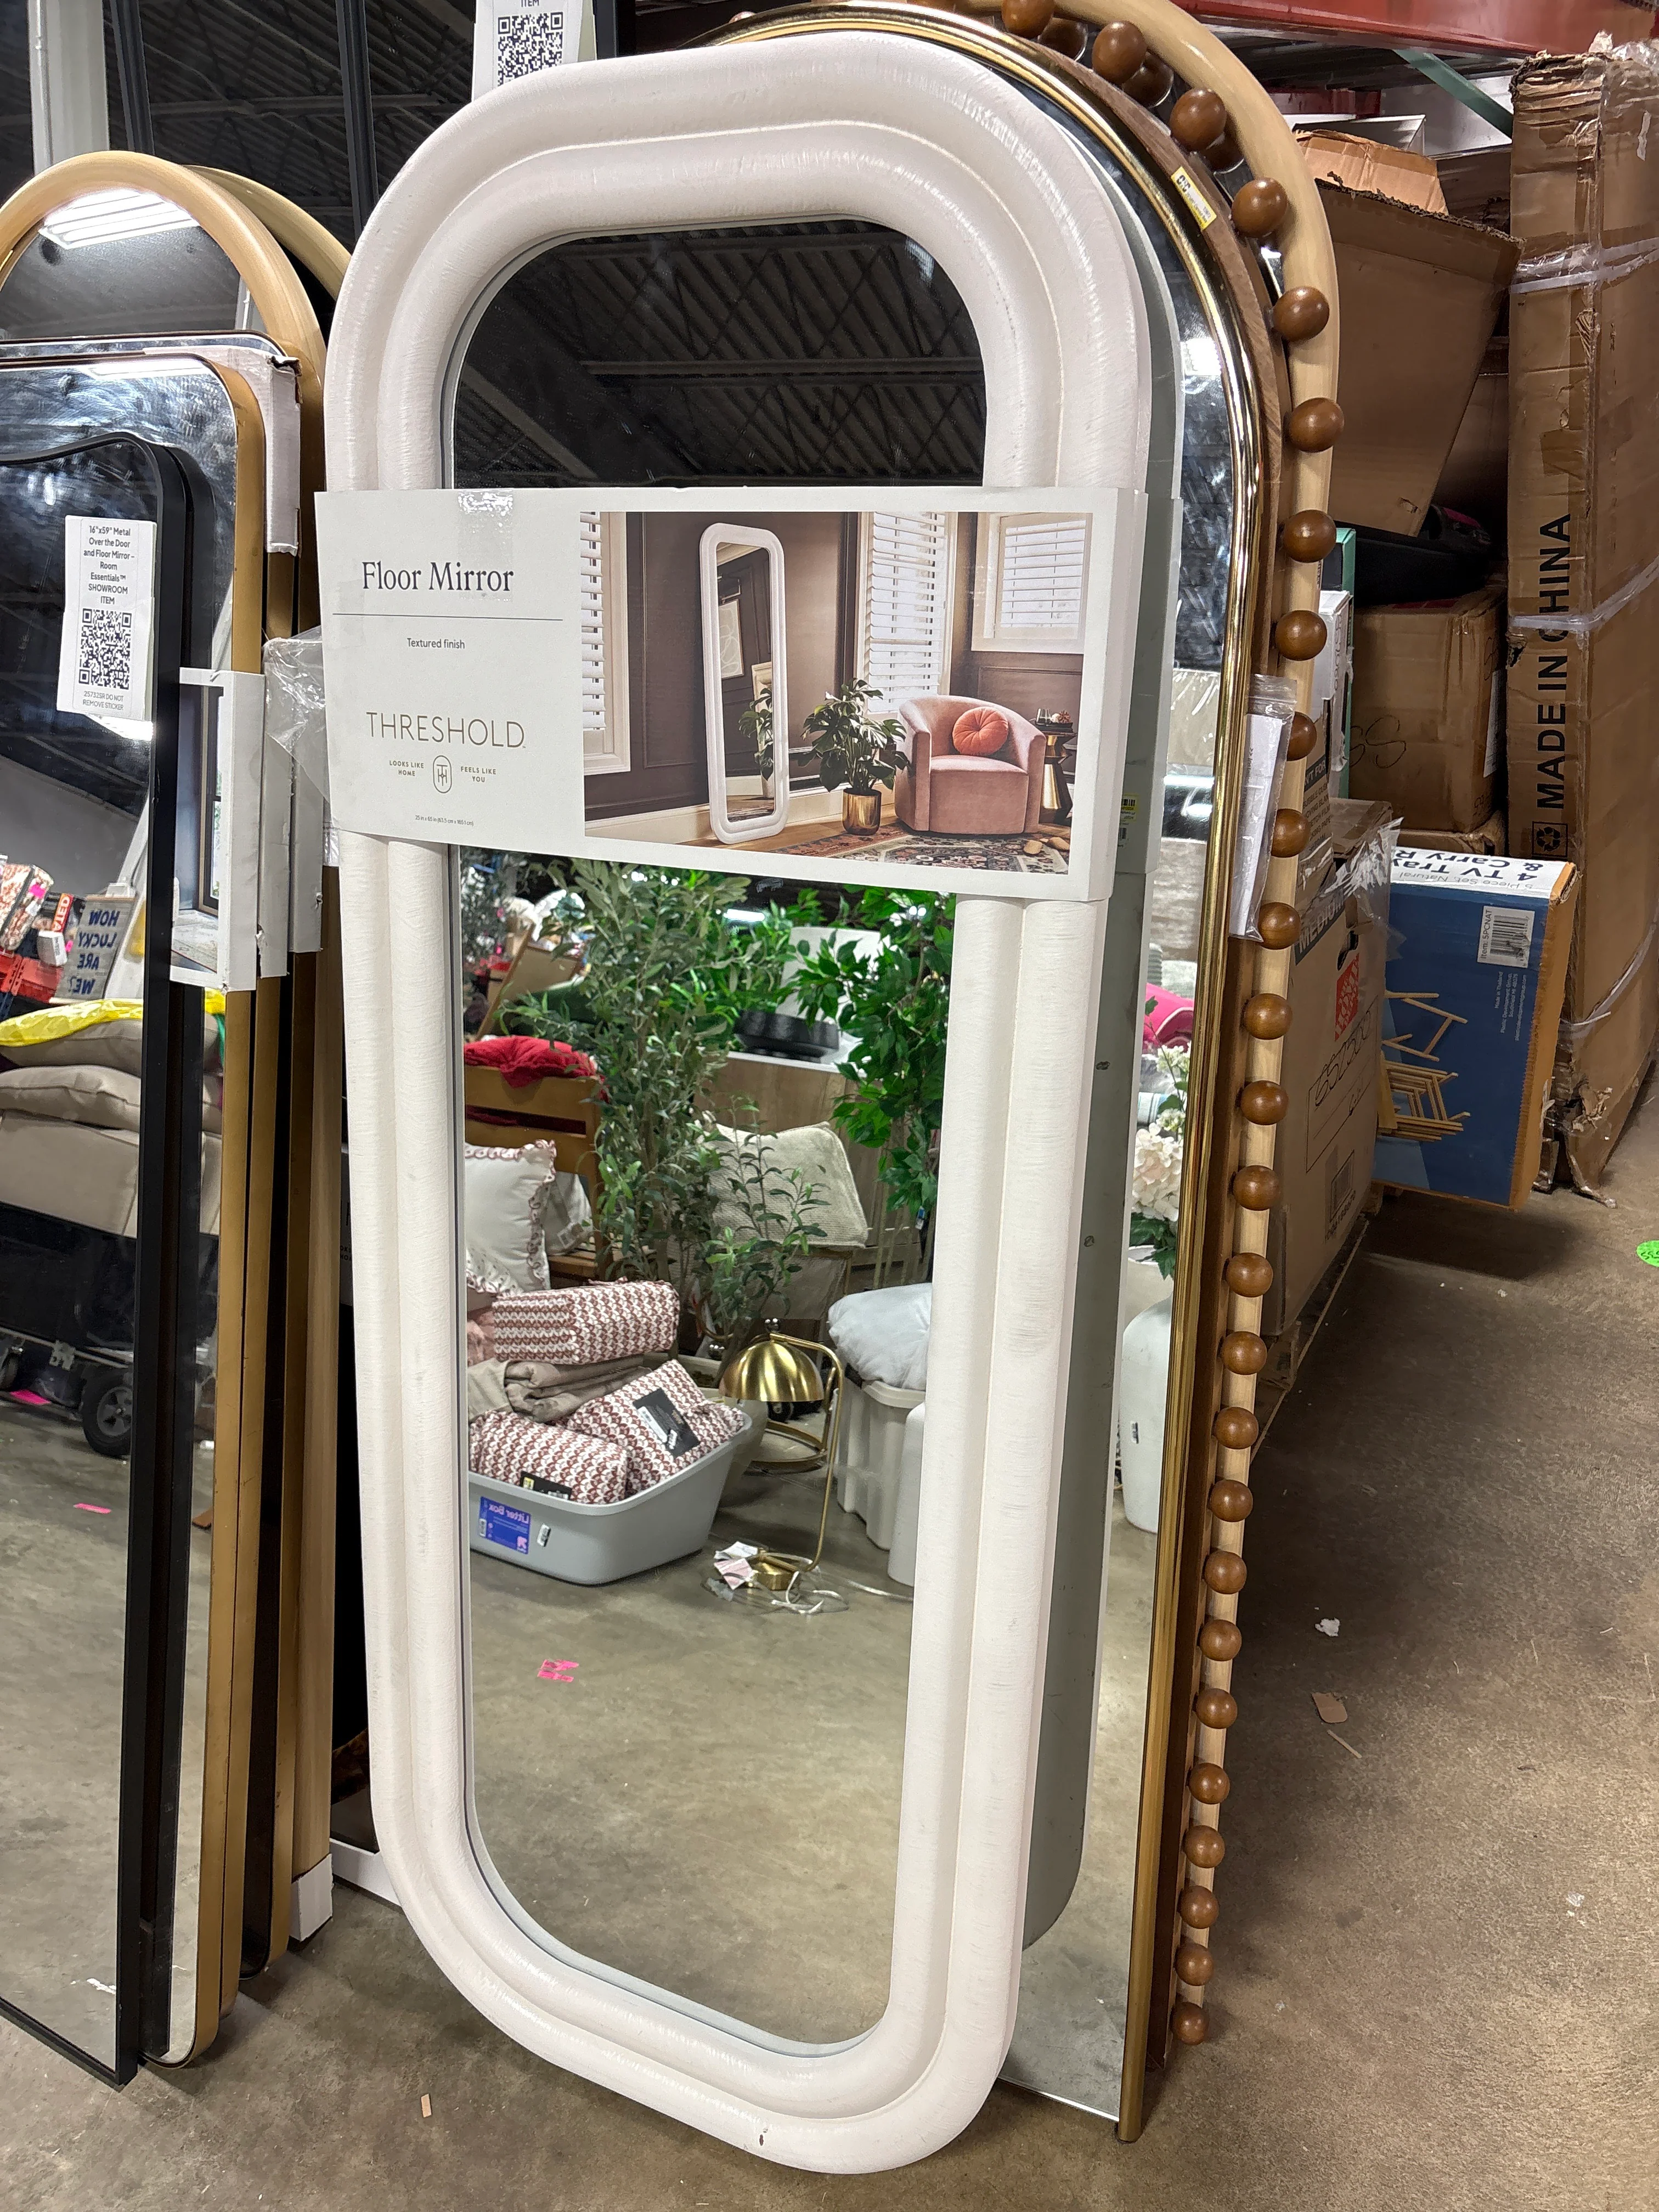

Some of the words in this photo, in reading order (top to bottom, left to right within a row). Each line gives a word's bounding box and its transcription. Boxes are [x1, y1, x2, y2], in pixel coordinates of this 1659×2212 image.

[113, 527, 131, 536] Metal
[89, 537, 104, 546] Over
[104, 539, 114, 547] the
[115, 539, 131, 548] Door
[95, 549, 110, 558] Floor
[111, 551, 131, 560] Mirror
[100, 561, 117, 570] Room
[362, 560, 422, 590] Floor
[428, 561, 514, 591] Mirror
[1538, 513, 1571, 643] CHINA
[88, 583, 128, 595] SHOWROOM
[100, 596, 115, 605] ITEM
[407, 637, 442, 648] Textured
[443, 639, 466, 649] finish
[1537, 656, 1568, 691] IN
[366, 712, 524, 748] THRESHOLD
[1537, 703, 1566, 810] MADE
[389, 760, 409, 768] LOOKS
[460, 766, 479, 774] FEELS
[1426, 852, 1510, 868] Carry
[1523, 862, 1544, 872] &
[1399, 871, 1449, 882] Natural
[1460, 867, 1504, 879] TV
[1517, 872, 1538, 881] 4
[1485, 879, 1520, 889] Piece
